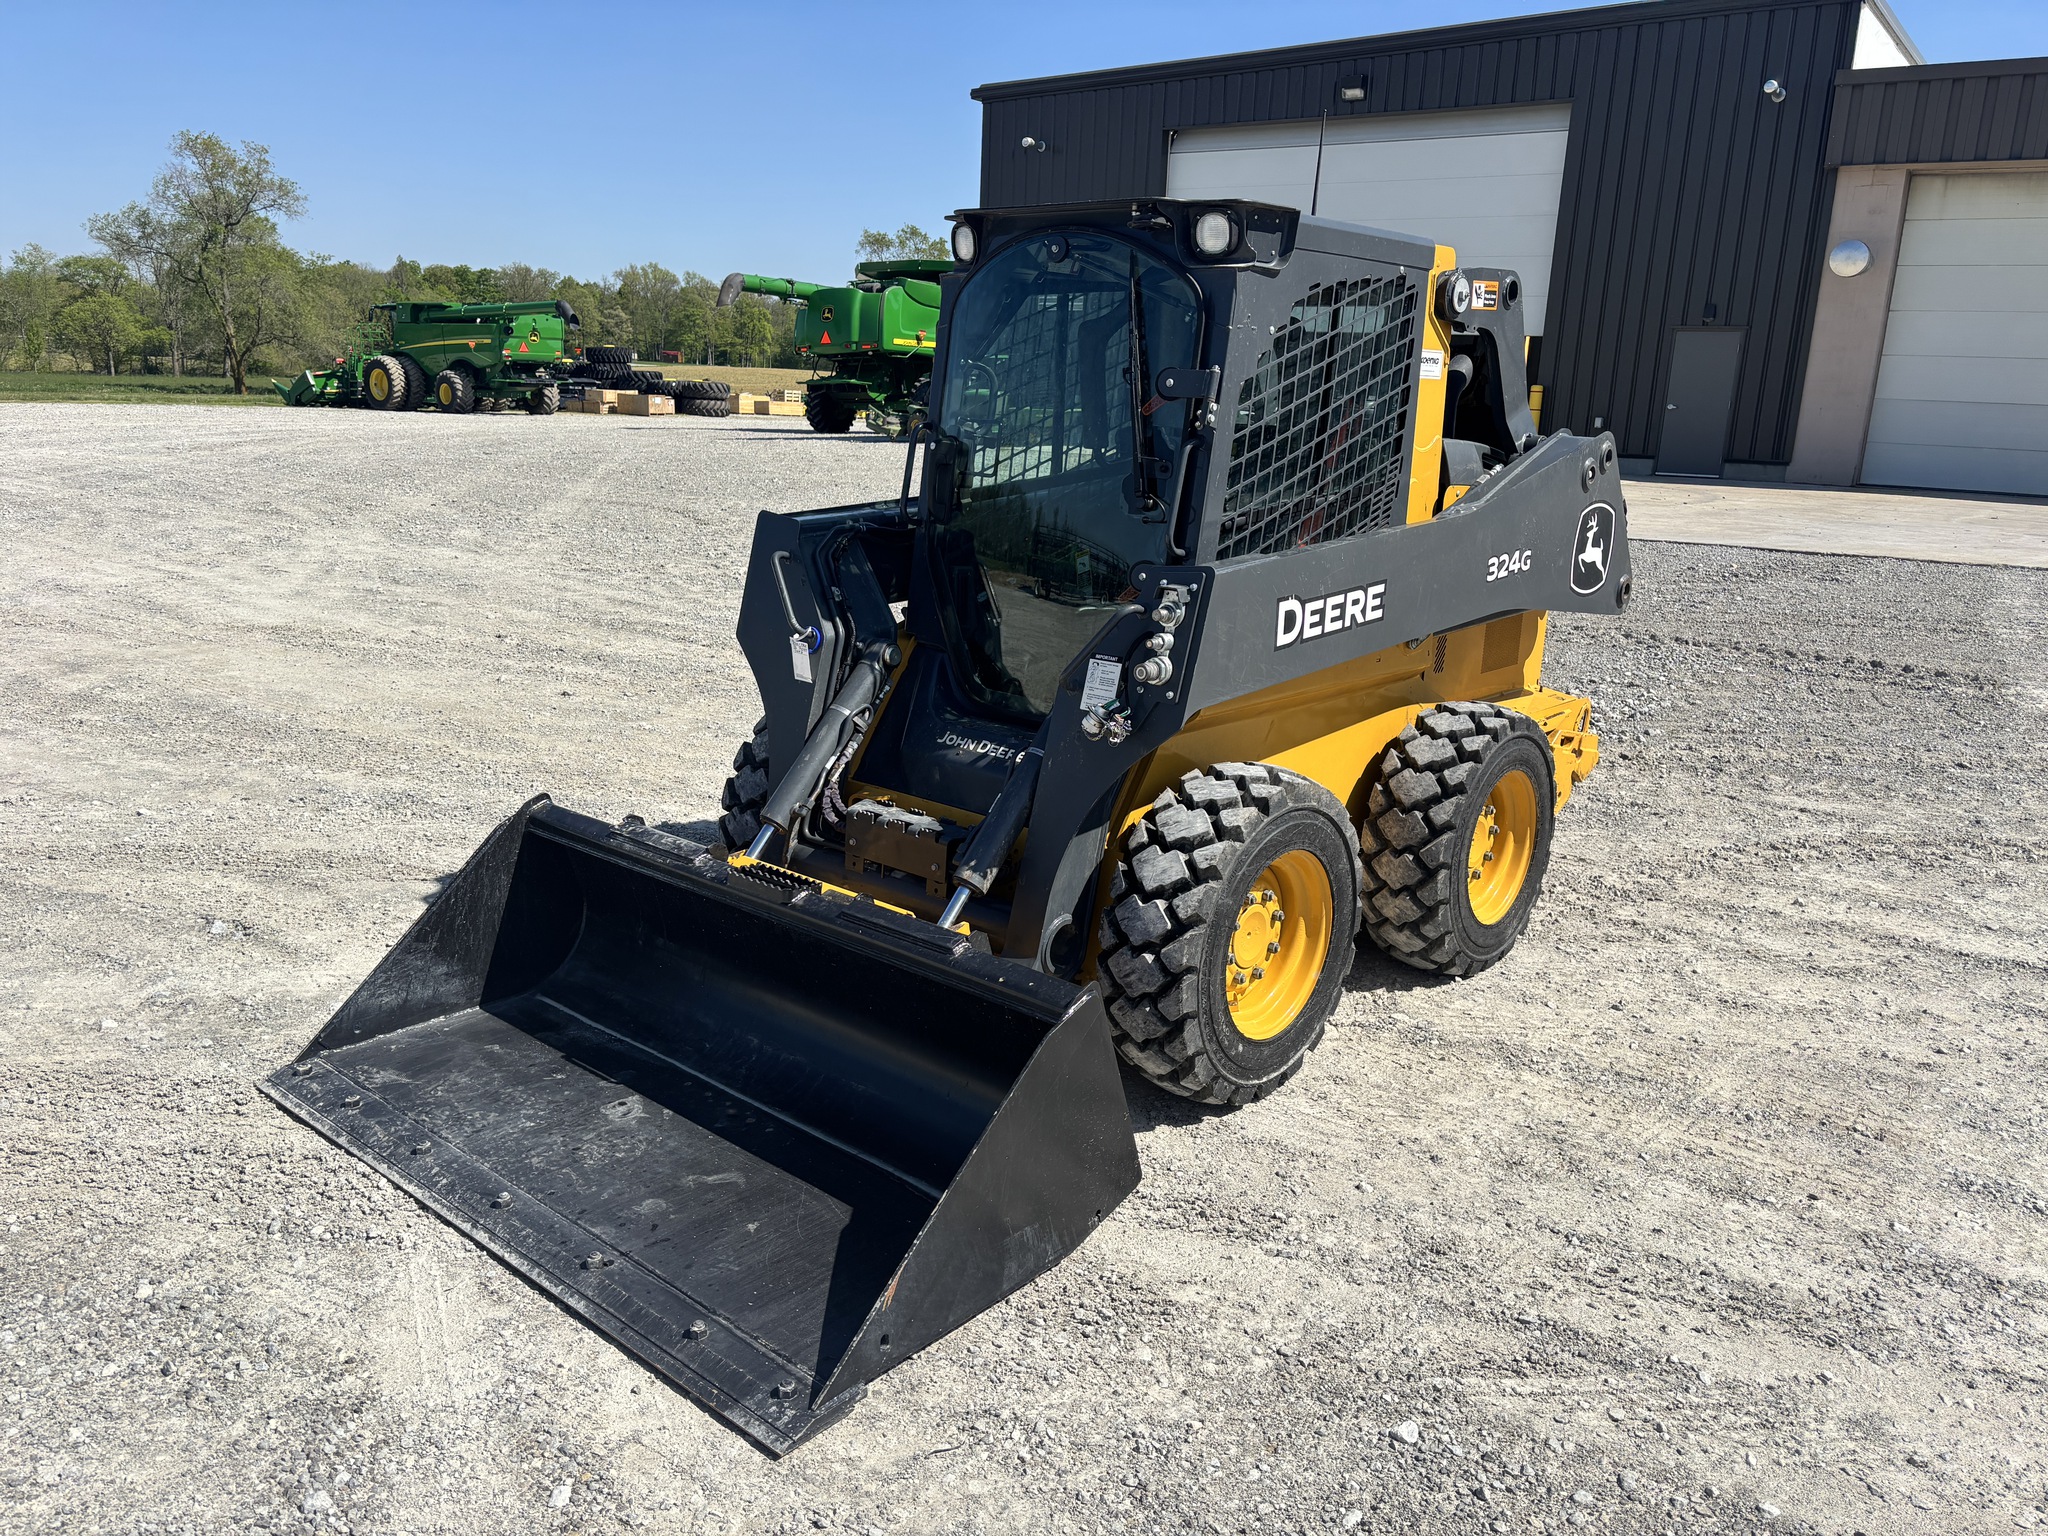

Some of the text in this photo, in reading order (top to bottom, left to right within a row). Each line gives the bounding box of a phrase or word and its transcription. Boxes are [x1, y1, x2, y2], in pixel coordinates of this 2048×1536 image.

[1486, 549, 1532, 582] 324G
[1276, 583, 1386, 647] DEERE
[1095, 653, 1119, 662] IMPORTANT
[936, 731, 978, 751] JOHN
